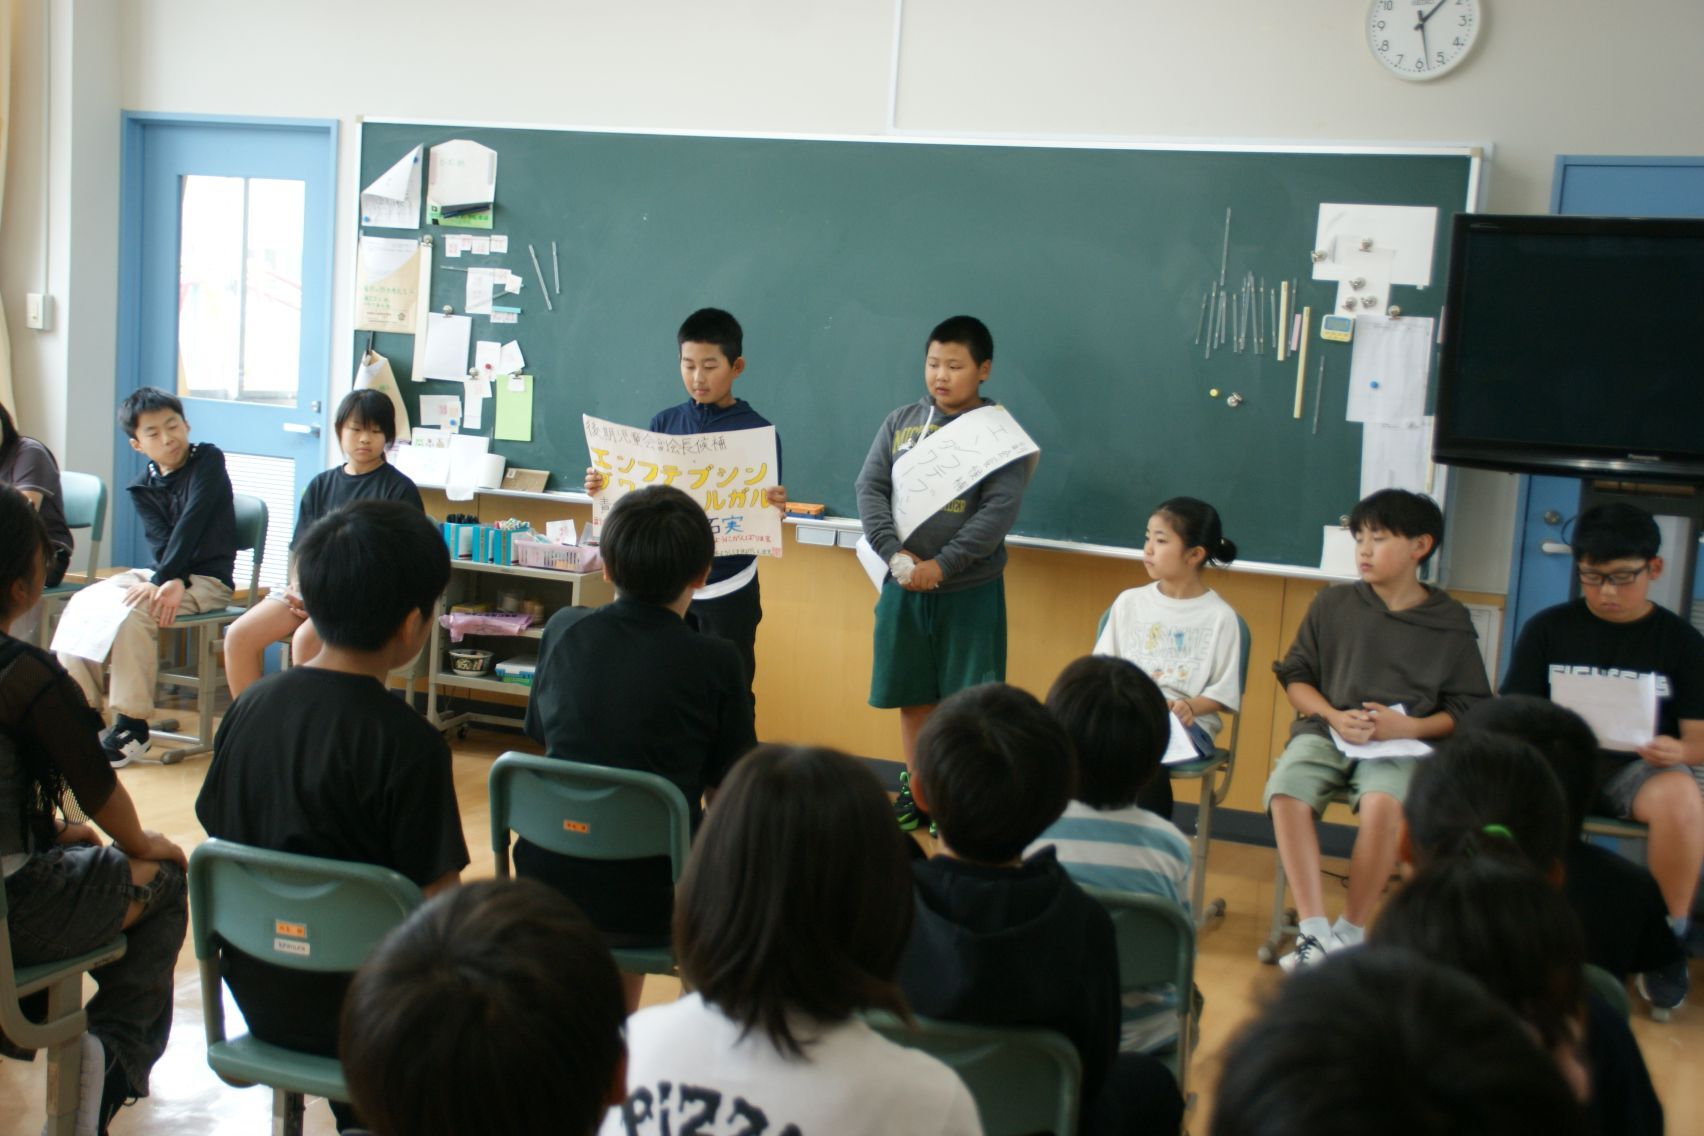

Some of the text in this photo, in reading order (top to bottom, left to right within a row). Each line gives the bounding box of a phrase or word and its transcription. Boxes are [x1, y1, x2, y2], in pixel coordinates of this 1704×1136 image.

[1377, 20, 1386, 32] 9
[1458, 15, 1468, 27] 3
[1381, 40, 1389, 52] 8
[1452, 37, 1464, 47] 4
[1396, 54, 1404, 65] 7
[1415, 58, 1424, 70] 6
[1436, 52, 1446, 65] 5
